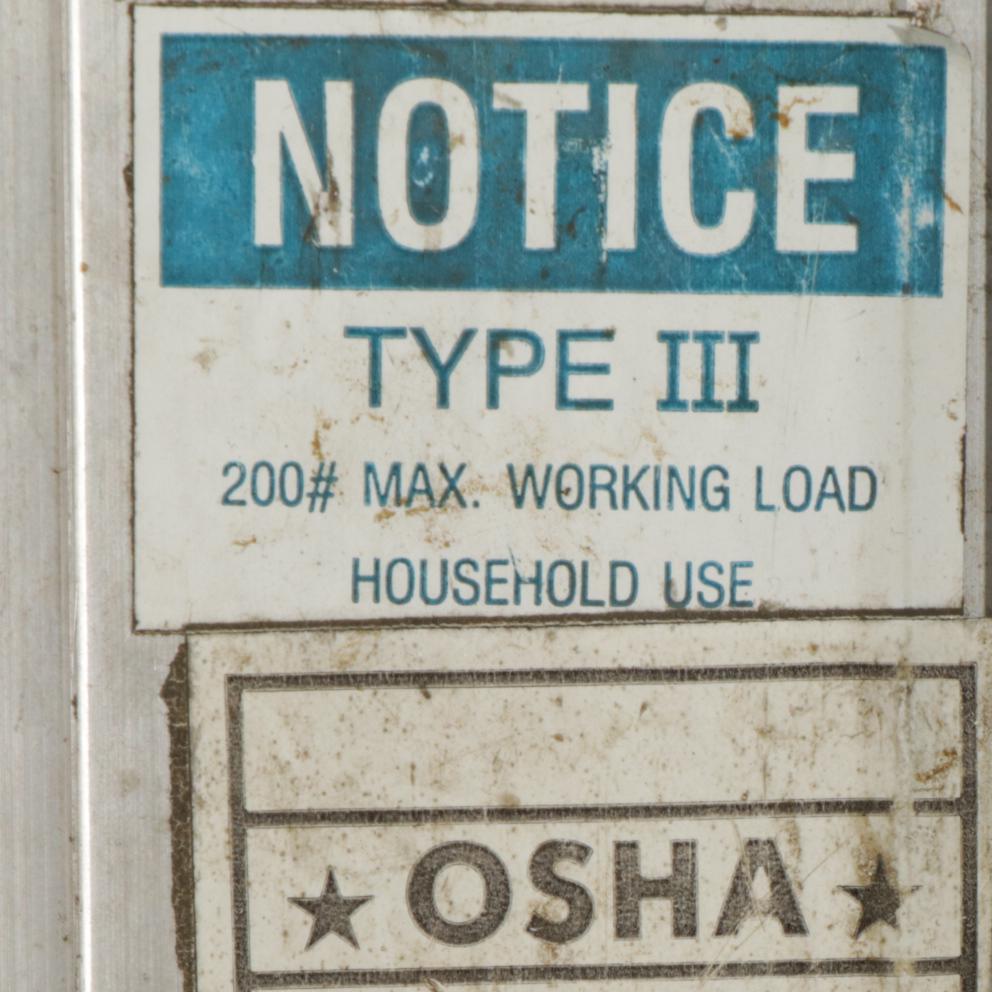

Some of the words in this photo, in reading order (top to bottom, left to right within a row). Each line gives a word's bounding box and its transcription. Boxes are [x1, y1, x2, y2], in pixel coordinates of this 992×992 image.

[252, 78, 860, 258] NOTICE
[343, 325, 614, 412] TYPE
[655, 330, 760, 414] III
[220, 460, 337, 513] 200#
[363, 462, 480, 511] MAX.
[507, 464, 730, 512] WORKING
[755, 465, 878, 512] LOAD
[350, 557, 639, 609] HOUSEHOLD
[664, 560, 755, 610] USE
[406, 838, 809, 946] OSHA
